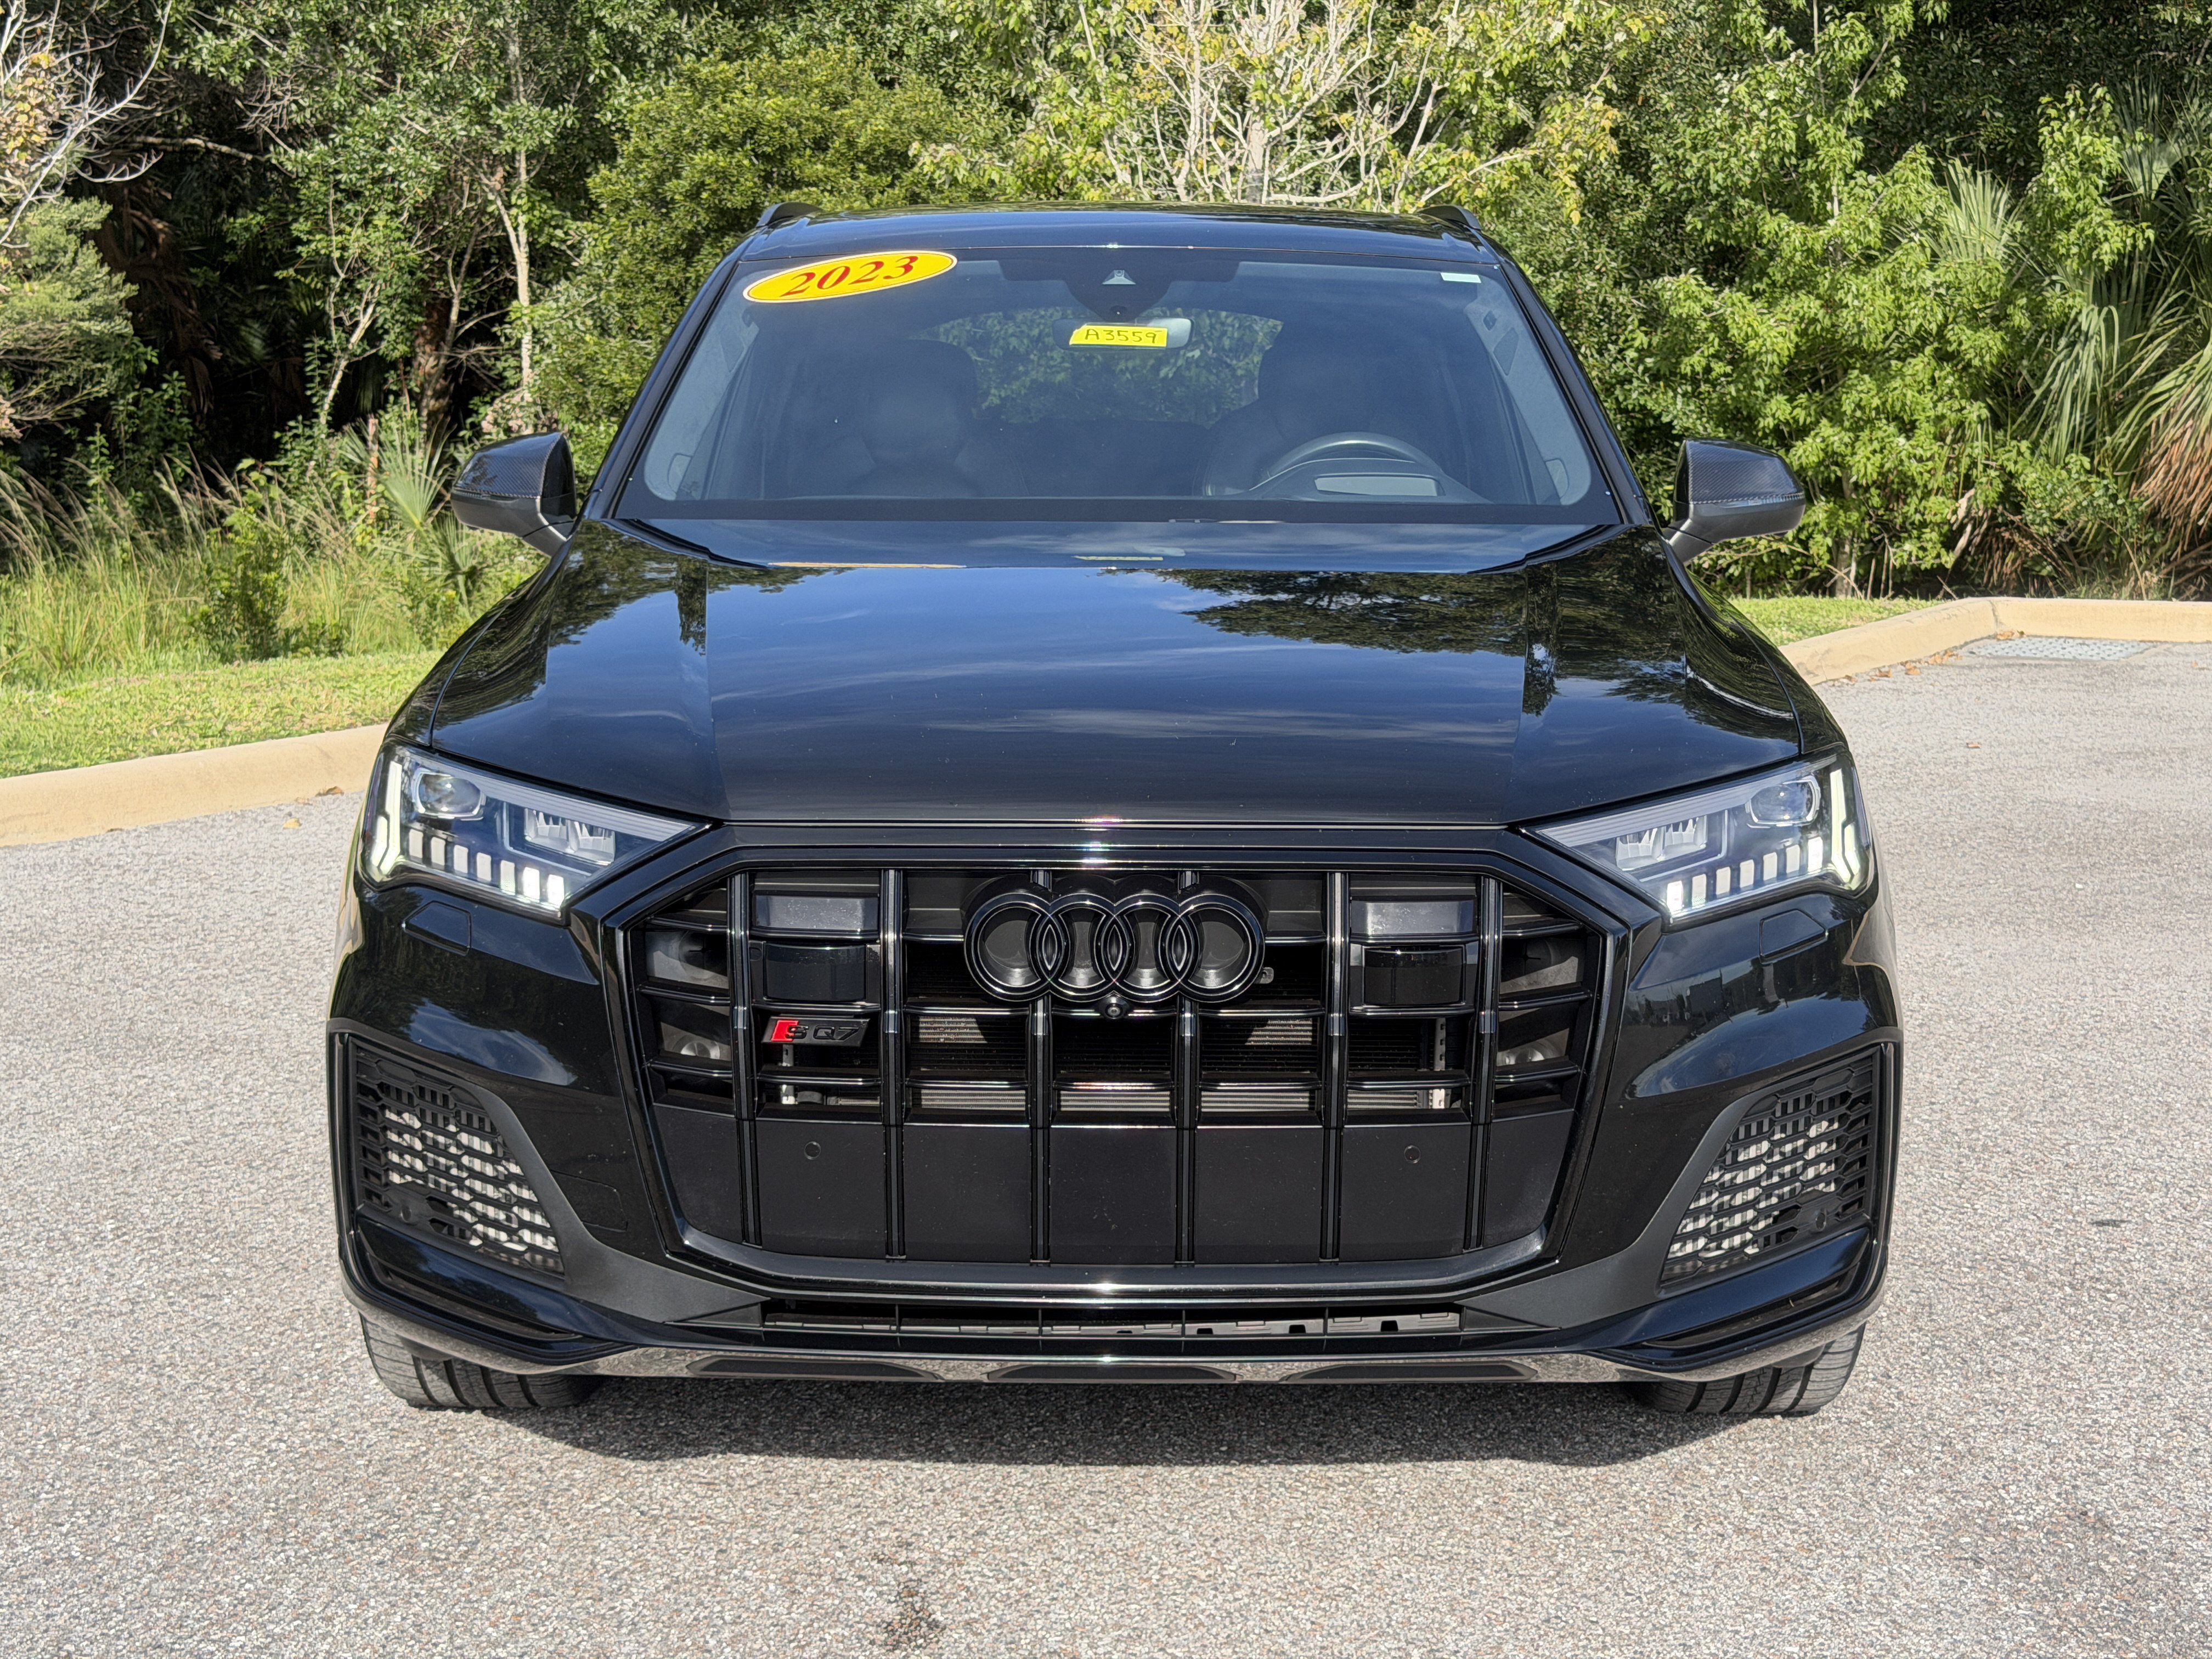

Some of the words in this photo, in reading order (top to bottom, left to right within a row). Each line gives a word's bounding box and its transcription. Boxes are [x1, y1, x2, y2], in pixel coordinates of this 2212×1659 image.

[779, 256, 919, 297] 2023
[1085, 329, 1158, 344] A3559
[784, 1024, 859, 1041] SQ7
